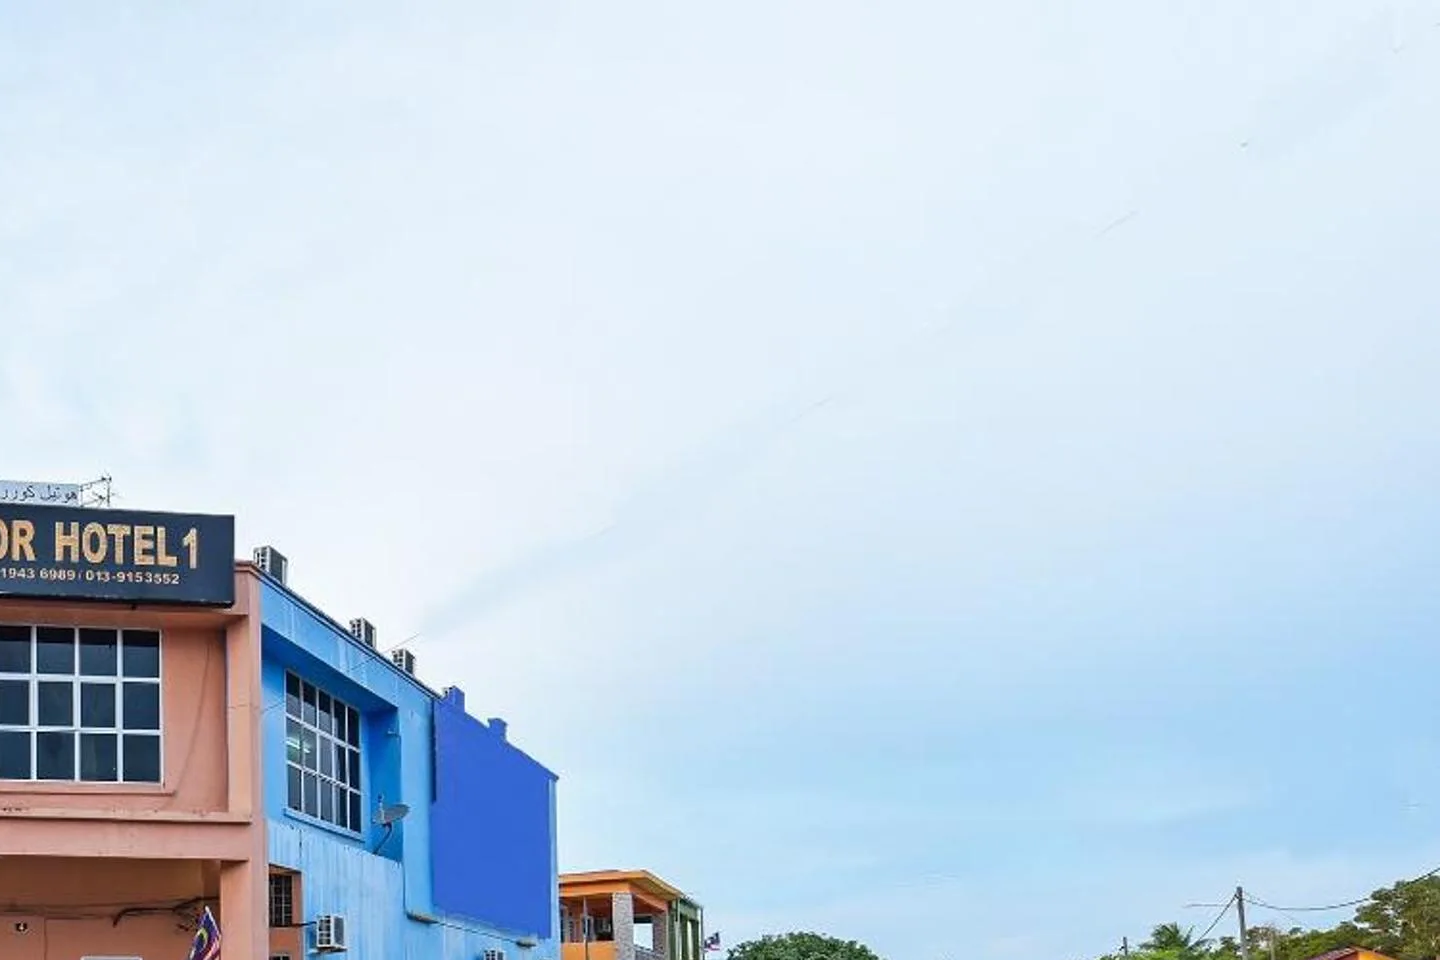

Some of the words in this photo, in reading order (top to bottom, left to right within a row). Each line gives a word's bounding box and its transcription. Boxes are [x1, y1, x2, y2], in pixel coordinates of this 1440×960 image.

[54, 521, 178, 568] HOTEL
[182, 527, 199, 569] 1
[39, 567, 76, 581] 6989
[85, 569, 180, 585] 013-9153552
